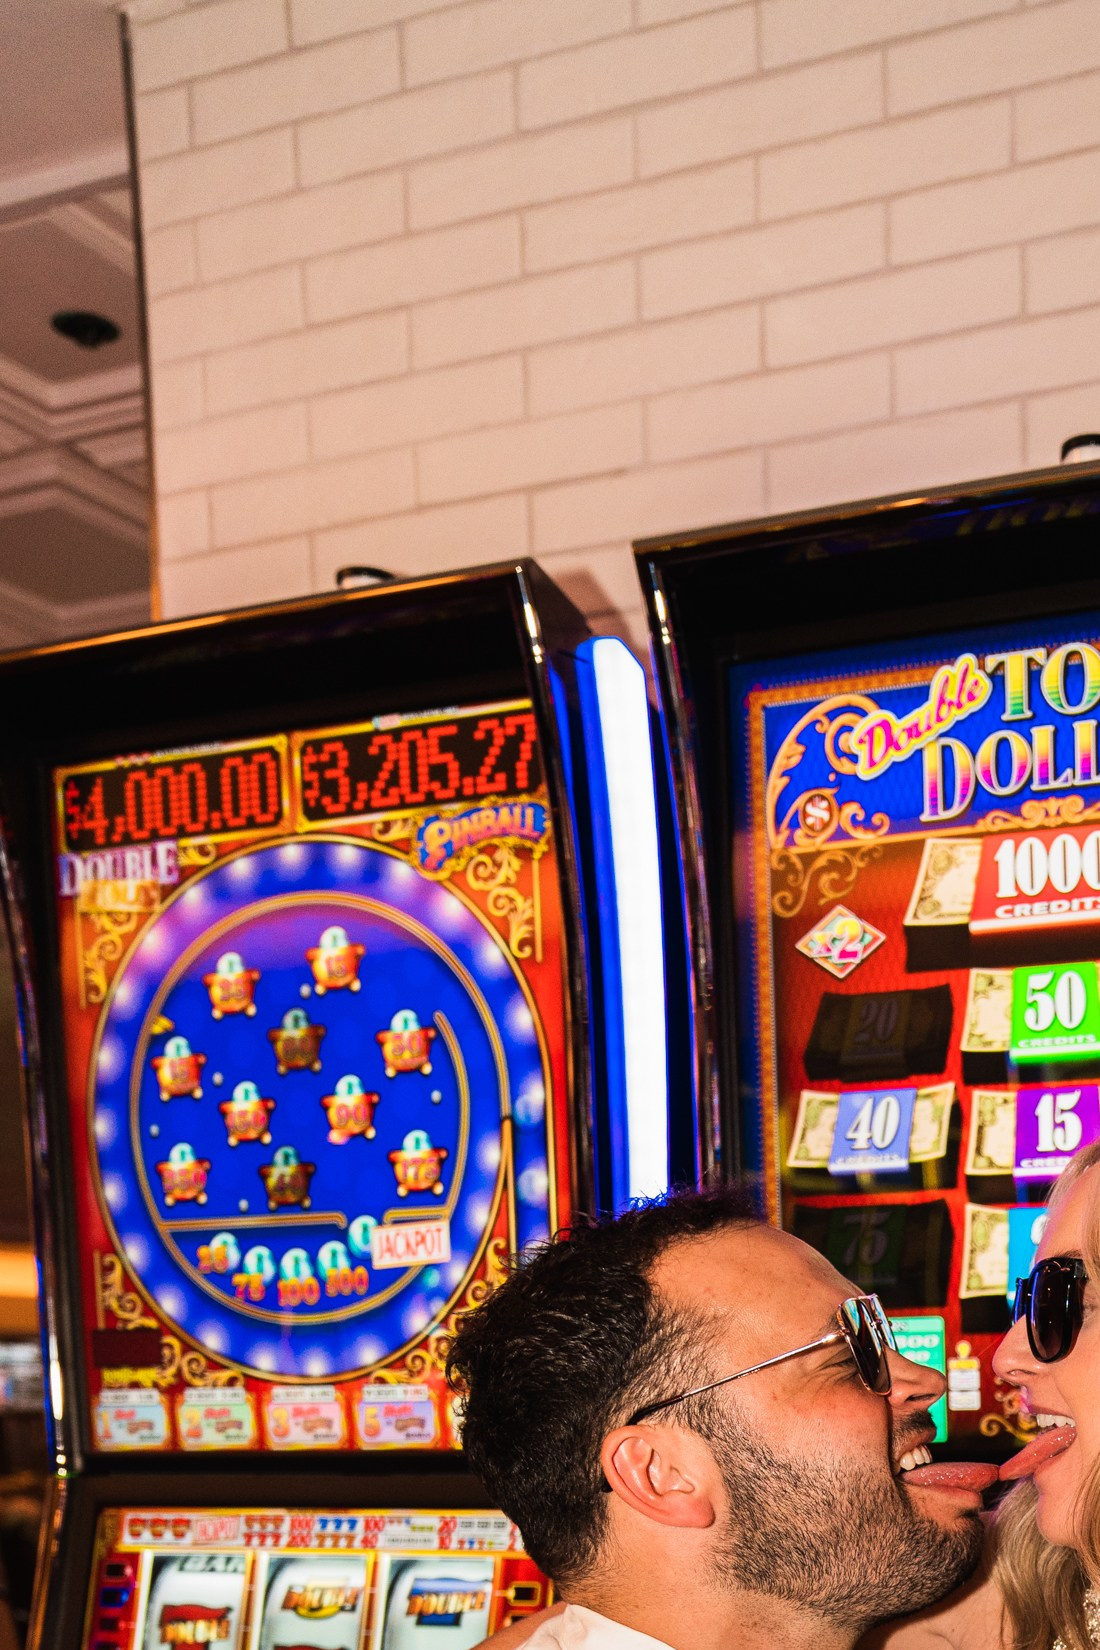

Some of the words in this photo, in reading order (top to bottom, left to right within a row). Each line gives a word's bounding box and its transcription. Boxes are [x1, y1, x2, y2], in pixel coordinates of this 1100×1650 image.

[854, 654, 991, 779] Double
[303, 713, 537, 815] $3,205.27
[65, 753, 278, 845] $4,000.00
[422, 804, 543, 871] PINBALL
[1024, 970, 1088, 1032] 50
[1017, 1033, 1097, 1049] CREDITS
[846, 1096, 901, 1150] 40
[1034, 1089, 1083, 1153] 15
[377, 1228, 443, 1261] JACKPOT
